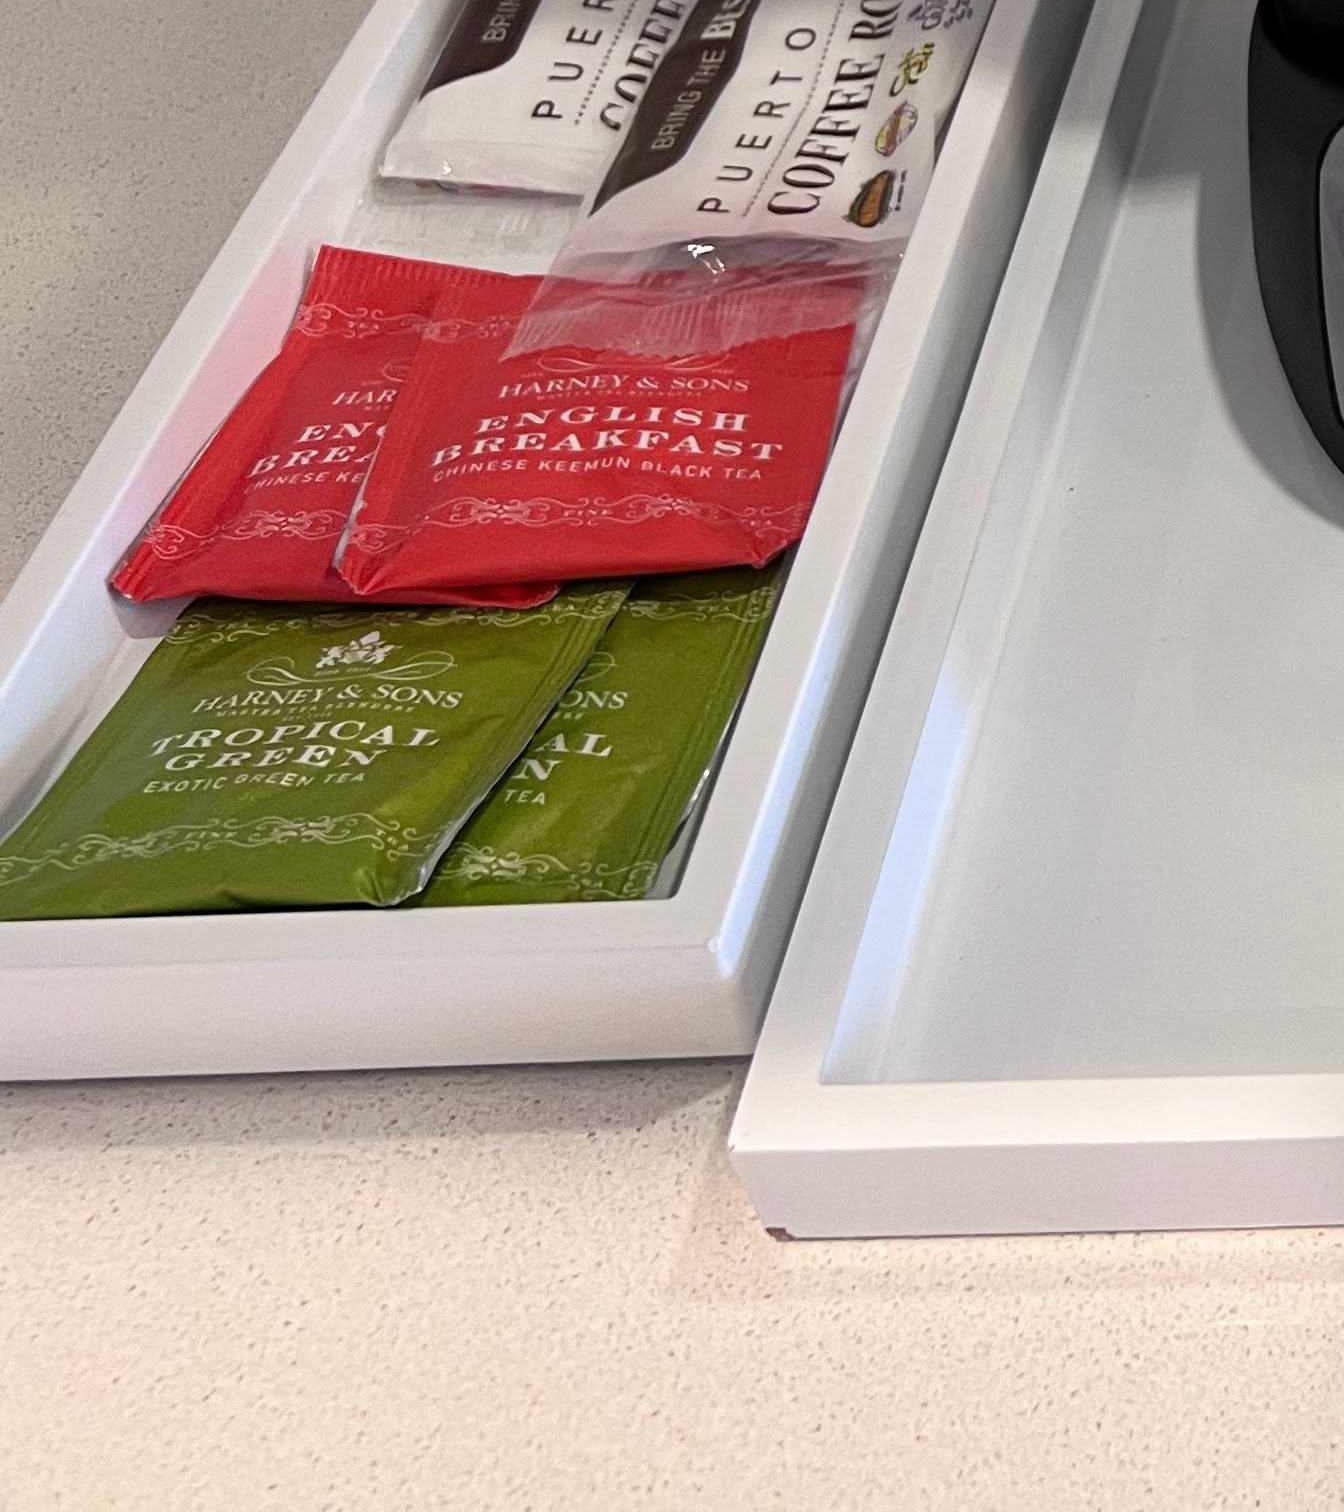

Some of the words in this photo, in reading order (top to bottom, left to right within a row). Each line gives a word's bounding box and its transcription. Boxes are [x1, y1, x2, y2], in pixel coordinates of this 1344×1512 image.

[651, 89, 702, 151] BRING
[687, 48, 726, 86] THE
[696, 27, 817, 214] PUERTO
[767, 53, 886, 215] COFFEE
[500, 374, 629, 399] HARNEY
[635, 374, 659, 390] &
[669, 376, 750, 393] SONS
[473, 405, 751, 434] ENGLISH
[430, 429, 783, 467] BREAKFAST
[433, 458, 528, 483] CHINESE
[538, 456, 631, 473] KEEMUN
[641, 460, 713, 479] BLACK
[723, 467, 763, 480] TEA
[192, 687, 331, 714] HARNEY
[335, 683, 364, 700] &
[372, 683, 464, 710] SONS
[149, 720, 441, 757] TROPICAL
[164, 744, 388, 772] GREEN
[143, 775, 229, 794] EXOTIC
[234, 771, 316, 788] GREEN
[323, 772, 366, 786] TEA
[504, 789, 546, 806] TEA
